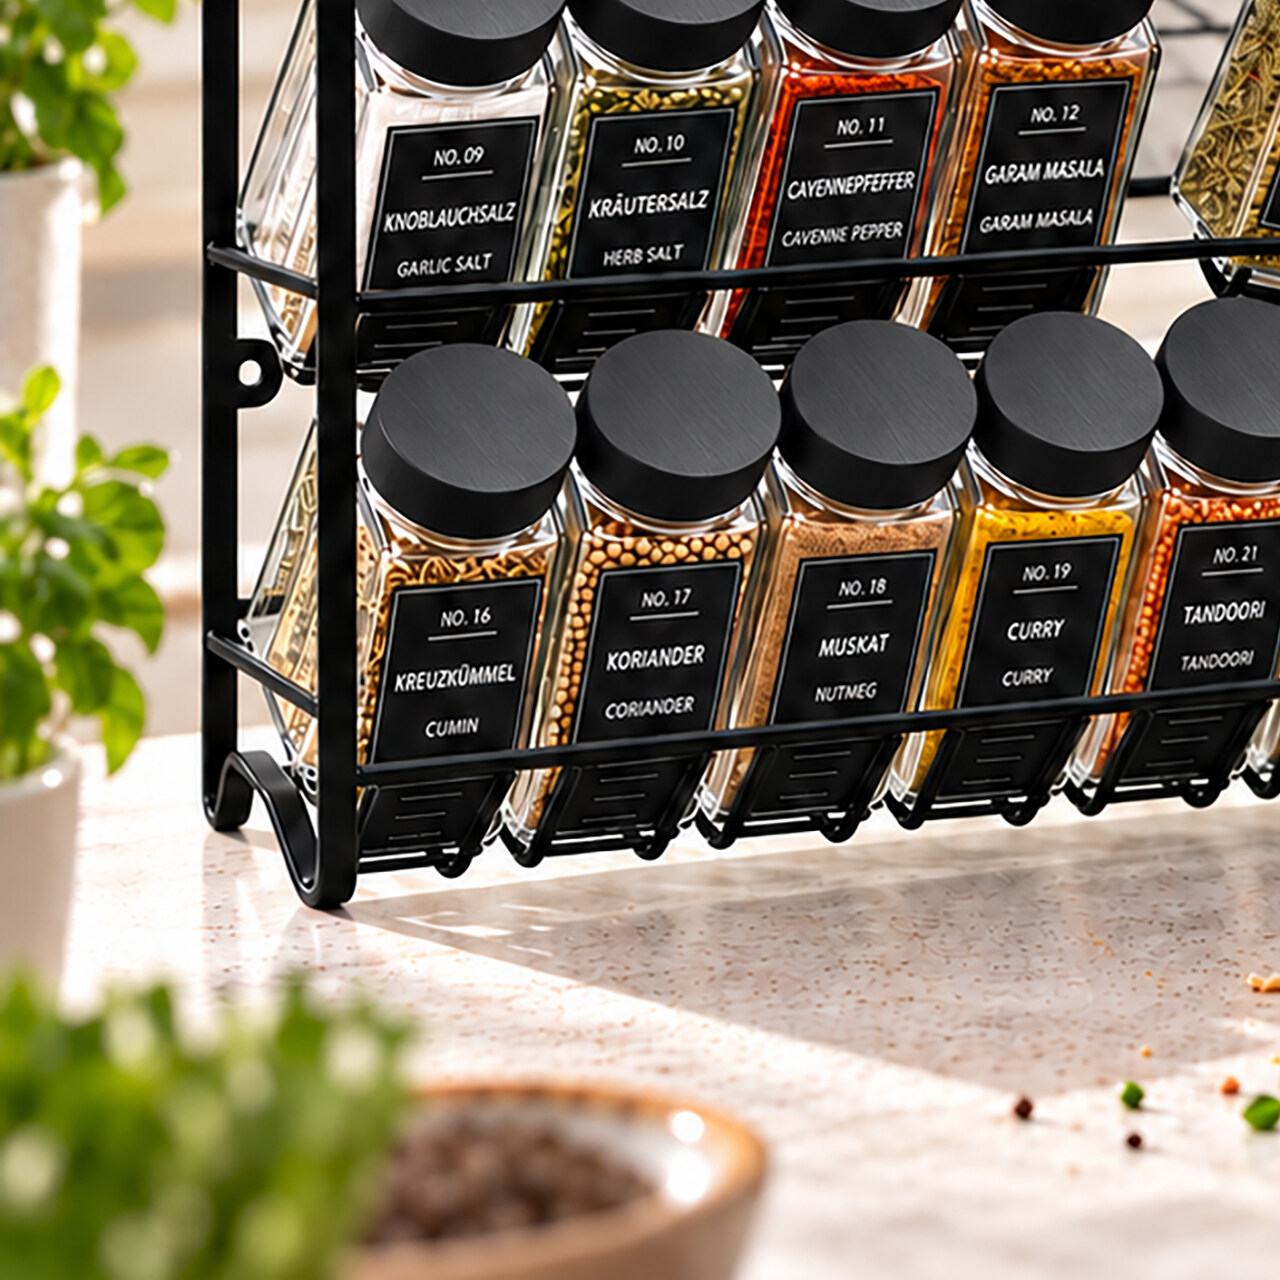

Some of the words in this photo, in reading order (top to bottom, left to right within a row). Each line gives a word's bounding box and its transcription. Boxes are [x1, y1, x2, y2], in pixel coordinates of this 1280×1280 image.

[1031, 107, 1056, 122] NO.
[1063, 105, 1079, 120] 12
[837, 119, 862, 135] NO.
[870, 117, 884, 132] 11
[635, 137, 662, 153] NO.
[668, 134, 684, 150] 10
[434, 149, 460, 165] NO.
[464, 146, 484, 163] 09
[984, 164, 1041, 185] GARAM
[1042, 158, 1105, 181] MASALA
[787, 170, 915, 200] CAYENNEPFEFFER
[588, 190, 709, 218] KRÄUTERSALZ
[383, 201, 517, 232] KNOBLAUCHSALZ
[980, 214, 1033, 233] GARAM
[1036, 209, 1092, 227] MASALA
[851, 222, 904, 242] PEPPER
[604, 248, 643, 265] HERB
[647, 244, 683, 262] SALT
[397, 257, 451, 277] GARLIC
[455, 253, 492, 272] SALT
[1214, 547, 1238, 563] NO.
[1242, 546, 1257, 561] 21
[1023, 565, 1049, 580] NO.
[1055, 563, 1071, 578] 19
[839, 580, 865, 595] NO.
[870, 578, 886, 594] 18
[642, 591, 669, 607] NO.
[675, 588, 691, 604] 17
[441, 610, 467, 626] NO.
[474, 607, 491, 623] 16
[1185, 601, 1265, 624] TANDOORI
[1008, 619, 1065, 640] CURRY
[819, 633, 889, 657] MUSKAT
[607, 645, 705, 670] KORIANDER
[1183, 651, 1254, 669] TANDOORI
[1002, 668, 1053, 686] CURRY
[816, 682, 876, 701] NUTMEG
[605, 696, 694, 719] CORIANDER
[426, 718, 478, 737] CUMIN
